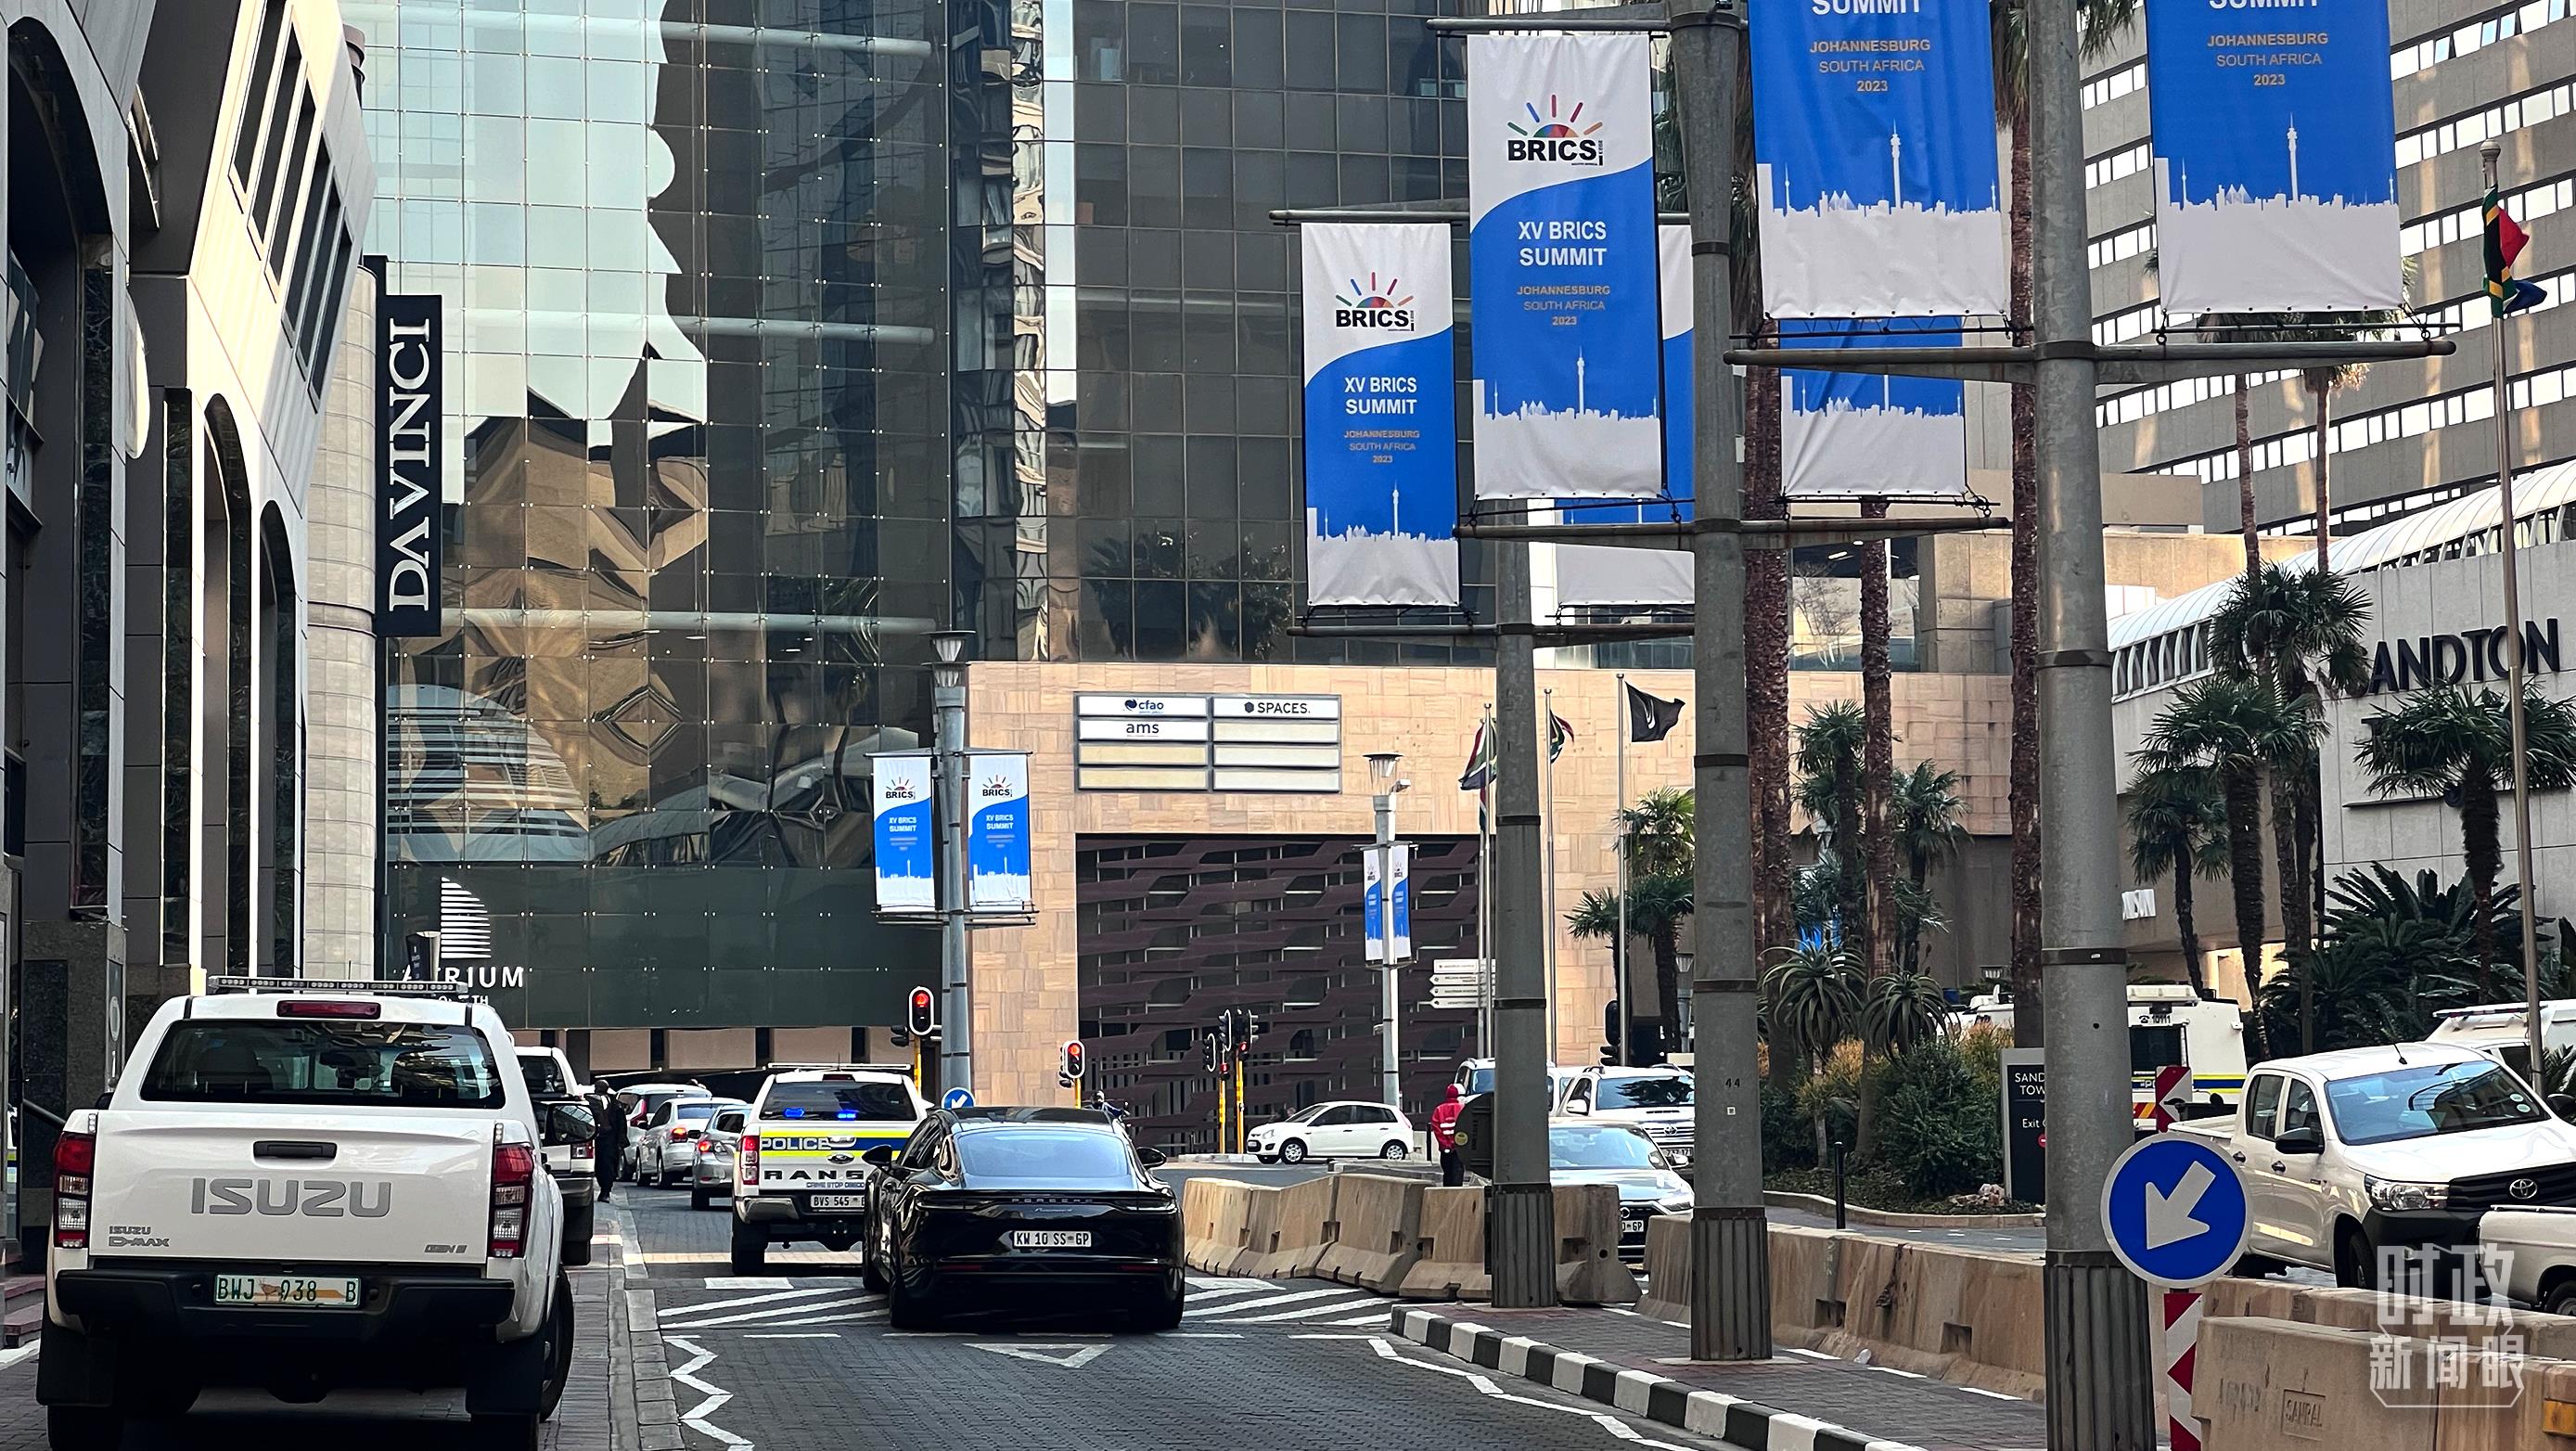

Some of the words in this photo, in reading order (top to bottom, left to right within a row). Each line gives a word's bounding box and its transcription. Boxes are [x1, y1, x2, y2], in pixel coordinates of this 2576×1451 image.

[1810, 39, 1930, 53] JOHANNESBURG
[2208, 32, 2329, 47] JOHANNESBURG
[1819, 60, 1869, 72] SOUTH
[1872, 59, 1925, 71] AFRICA
[2216, 54, 2266, 67] SOUTH
[2269, 53, 2323, 66] AFRICA
[2253, 73, 2286, 85] 2023
[1856, 80, 1889, 92] 2023
[1507, 139, 1597, 161] BRICS
[1519, 221, 1544, 240] XV
[1549, 221, 1607, 240] BRICS
[1519, 247, 1608, 266] SUMMIT
[1517, 285, 1610, 295] JOHANNESBURG
[1523, 301, 1562, 311] SOUTH
[1565, 300, 1606, 311] AFRICA
[1336, 310, 1409, 327] BRICS
[1552, 315, 1577, 327] 2023
[1344, 377, 1365, 393] XV
[1369, 377, 1417, 393] BRICS
[1345, 399, 1417, 414] SUMMIT
[1344, 430, 1420, 439] JOHANNESBURG
[2347, 618, 2560, 696] ANDTON
[1138, 700, 1164, 711] cfao
[1125, 723, 1160, 734] ams
[403, 965, 525, 989] RIUM
[2022, 1118, 2040, 1128] Exit
[761, 1137, 832, 1150] POLICE
[191, 1177, 391, 1218] ISUZU
[814, 1196, 829, 1206] BVS
[834, 1196, 850, 1206] 545
[109, 1226, 151, 1235] ISUZU
[109, 1236, 170, 1247] D-MAX
[1017, 1232, 1031, 1245] KW
[1034, 1232, 1048, 1245] 10
[1053, 1232, 1067, 1245] SS
[1075, 1232, 1089, 1245] GP
[218, 1278, 255, 1300] BWJ
[345, 1281, 356, 1303] B
